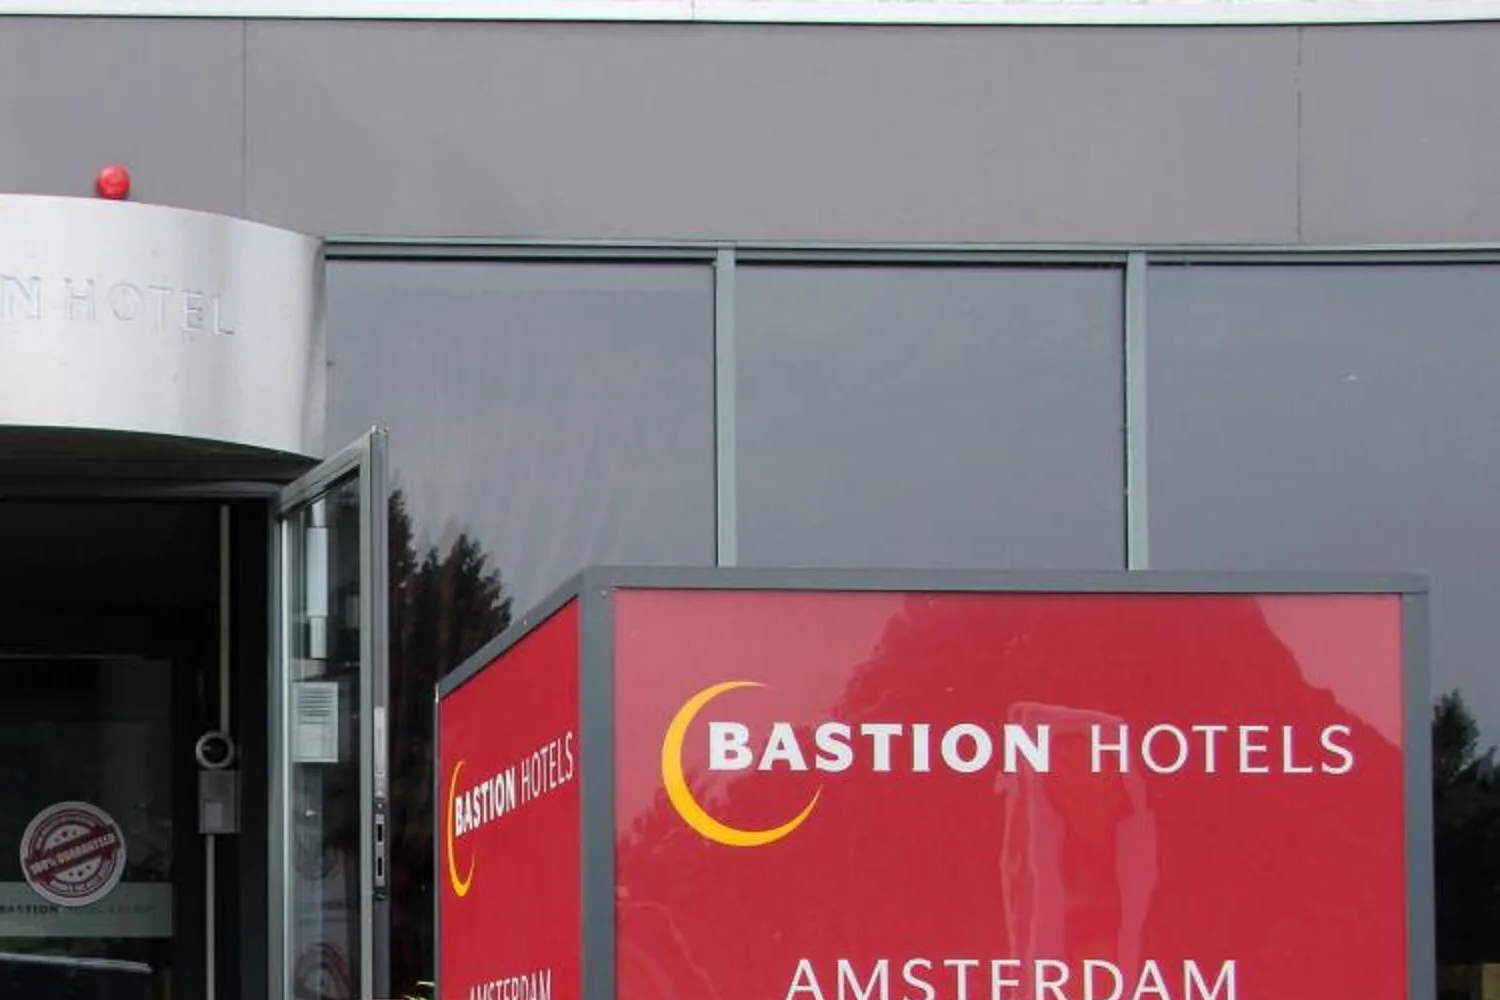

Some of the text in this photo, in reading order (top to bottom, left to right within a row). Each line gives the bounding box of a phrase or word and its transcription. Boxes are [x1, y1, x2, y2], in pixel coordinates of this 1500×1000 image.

[66, 276, 236, 337] HOTEL
[708, 722, 1354, 775] BASTION HOTELS
[455, 731, 574, 837] BASTION HOTELS
